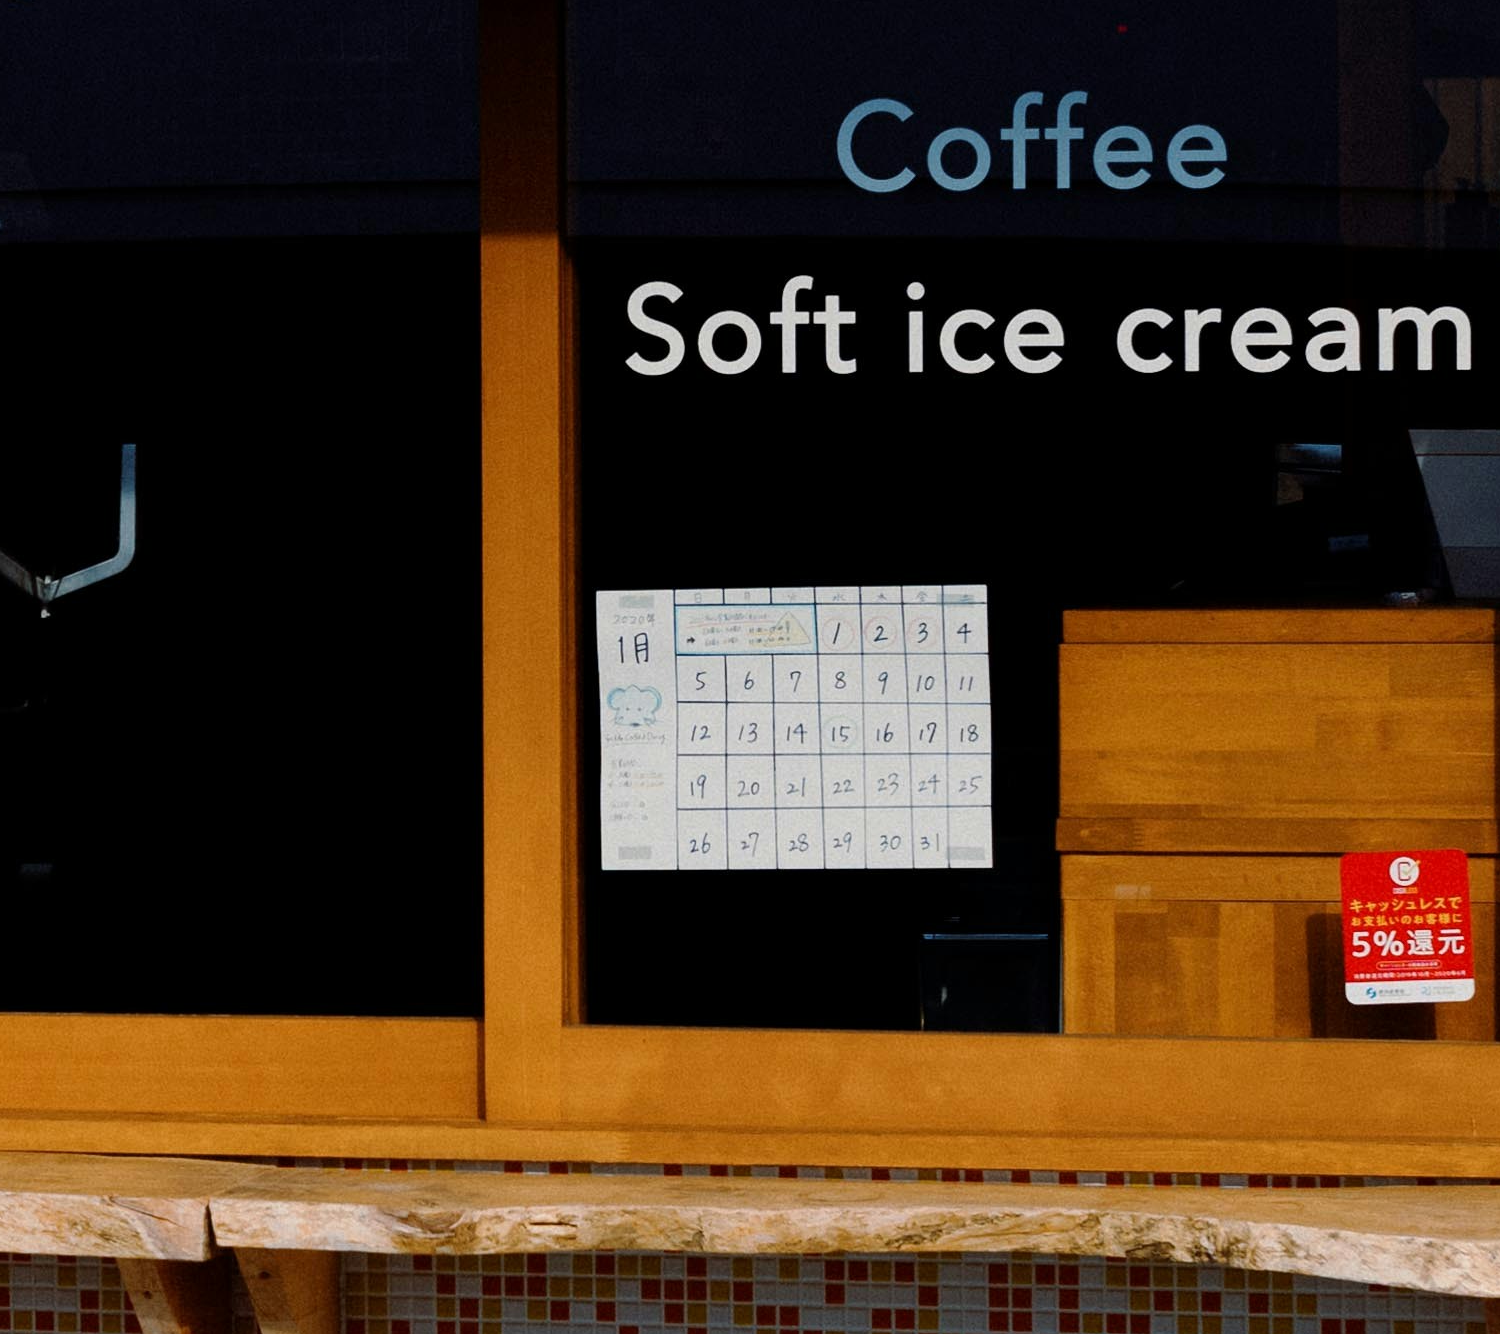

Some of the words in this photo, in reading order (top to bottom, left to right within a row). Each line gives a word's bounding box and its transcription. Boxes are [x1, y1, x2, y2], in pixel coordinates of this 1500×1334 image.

[837, 91, 1227, 192] Coffee
[625, 275, 857, 375] Soft
[906, 281, 1065, 373] ice
[1116, 306, 1472, 373] cream
[833, 623, 840, 644] 1
[874, 626, 888, 642] 2
[918, 622, 928, 643] 3
[957, 623, 972, 643] 4
[618, 632, 650, 664] 1月
[696, 671, 706, 690] 5
[744, 671, 754, 690] 6
[790, 671, 801, 692] 7
[835, 671, 846, 689] 8
[878, 672, 888, 694] 9
[917, 675, 935, 692] 10
[960, 677, 973, 691] 11
[691, 725, 711, 742] 12
[739, 723, 757, 743] 13
[787, 723, 807, 744] 14
[832, 726, 850, 742] 15
[877, 723, 893, 742] 16
[919, 722, 937, 743] 17
[960, 724, 979, 742] 18
[691, 775, 706, 799] 19
[738, 781, 759, 797] 20
[787, 778, 805, 796] 21
[834, 780, 854, 794] 22
[878, 773, 898, 791] 23
[918, 774, 940, 793] 24
[959, 776, 981, 792] 25
[690, 833, 710, 854] 26
[741, 832, 759, 855] 27
[789, 833, 808, 852] 28
[834, 832, 852, 852] 29
[880, 835, 901, 850] 30
[921, 834, 939, 851] 31
[1350, 896, 1462, 913] キャッシュレスで
[1351, 913, 1463, 927] お支払いのお客様に
[1352, 929, 1466, 958] 5%還元
